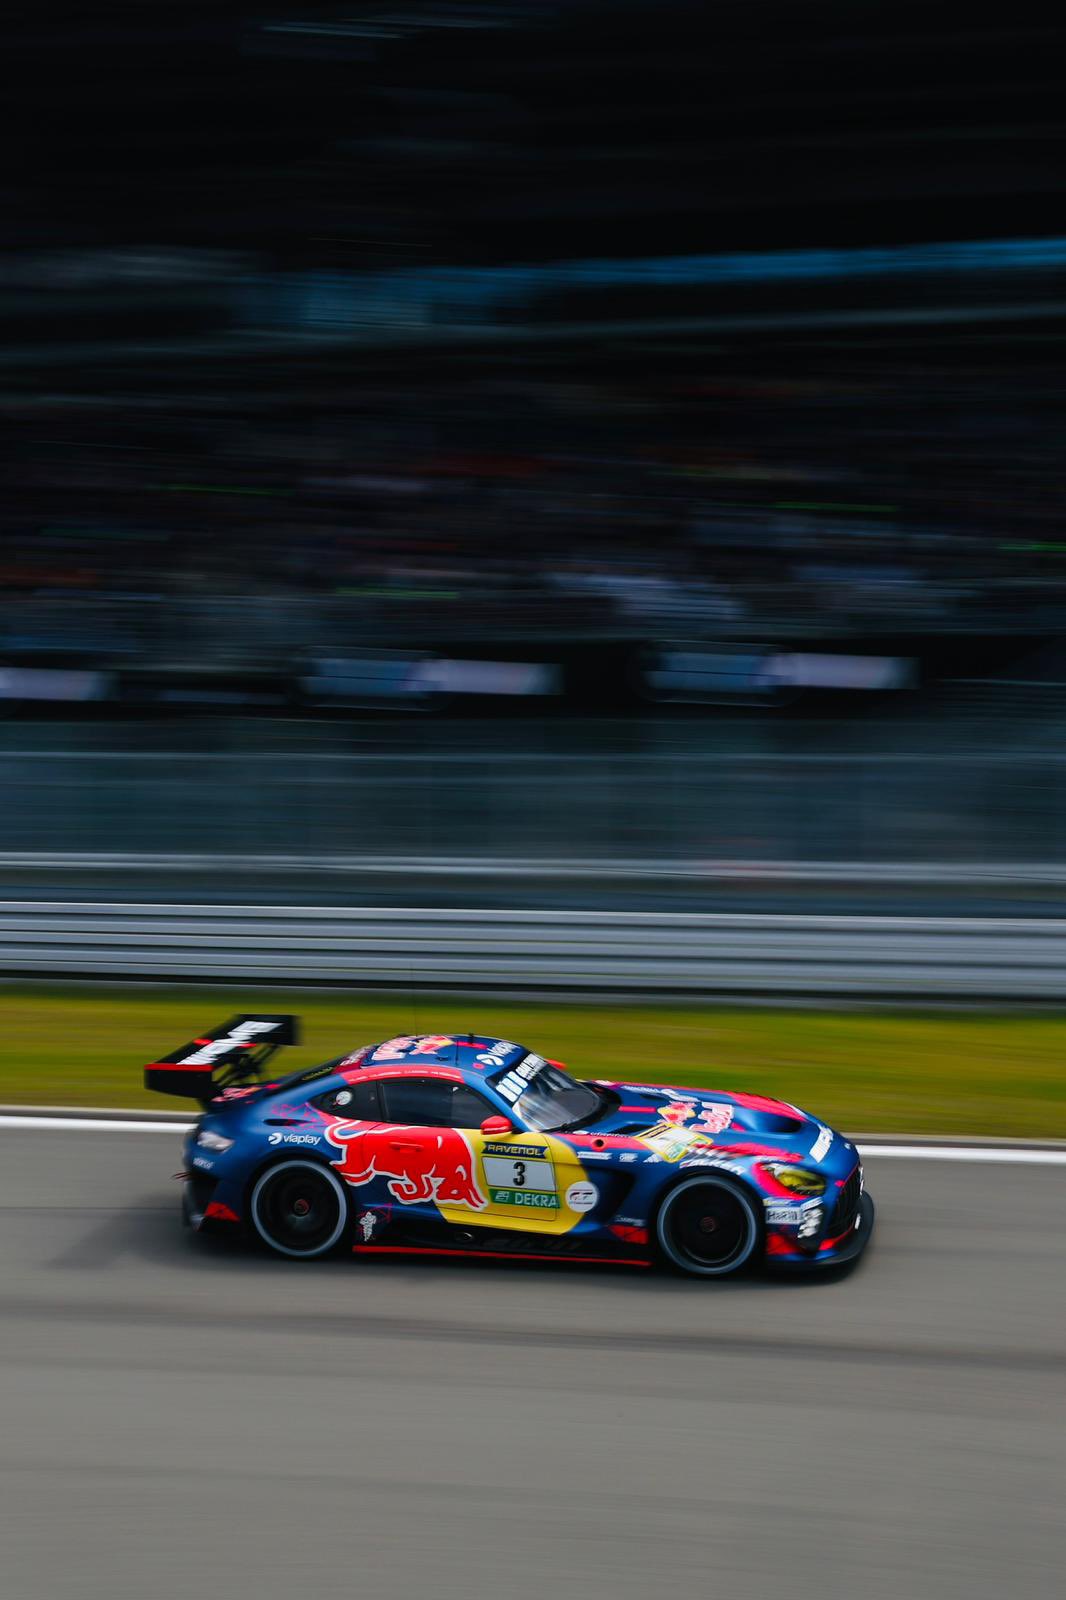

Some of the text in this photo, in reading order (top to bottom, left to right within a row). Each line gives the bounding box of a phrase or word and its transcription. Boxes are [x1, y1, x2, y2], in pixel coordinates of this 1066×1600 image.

[283, 1133, 321, 1146] viaplay
[487, 1144, 542, 1156] RAVENOL
[513, 1162, 525, 1186] 3
[514, 1192, 557, 1208] DEKRA
